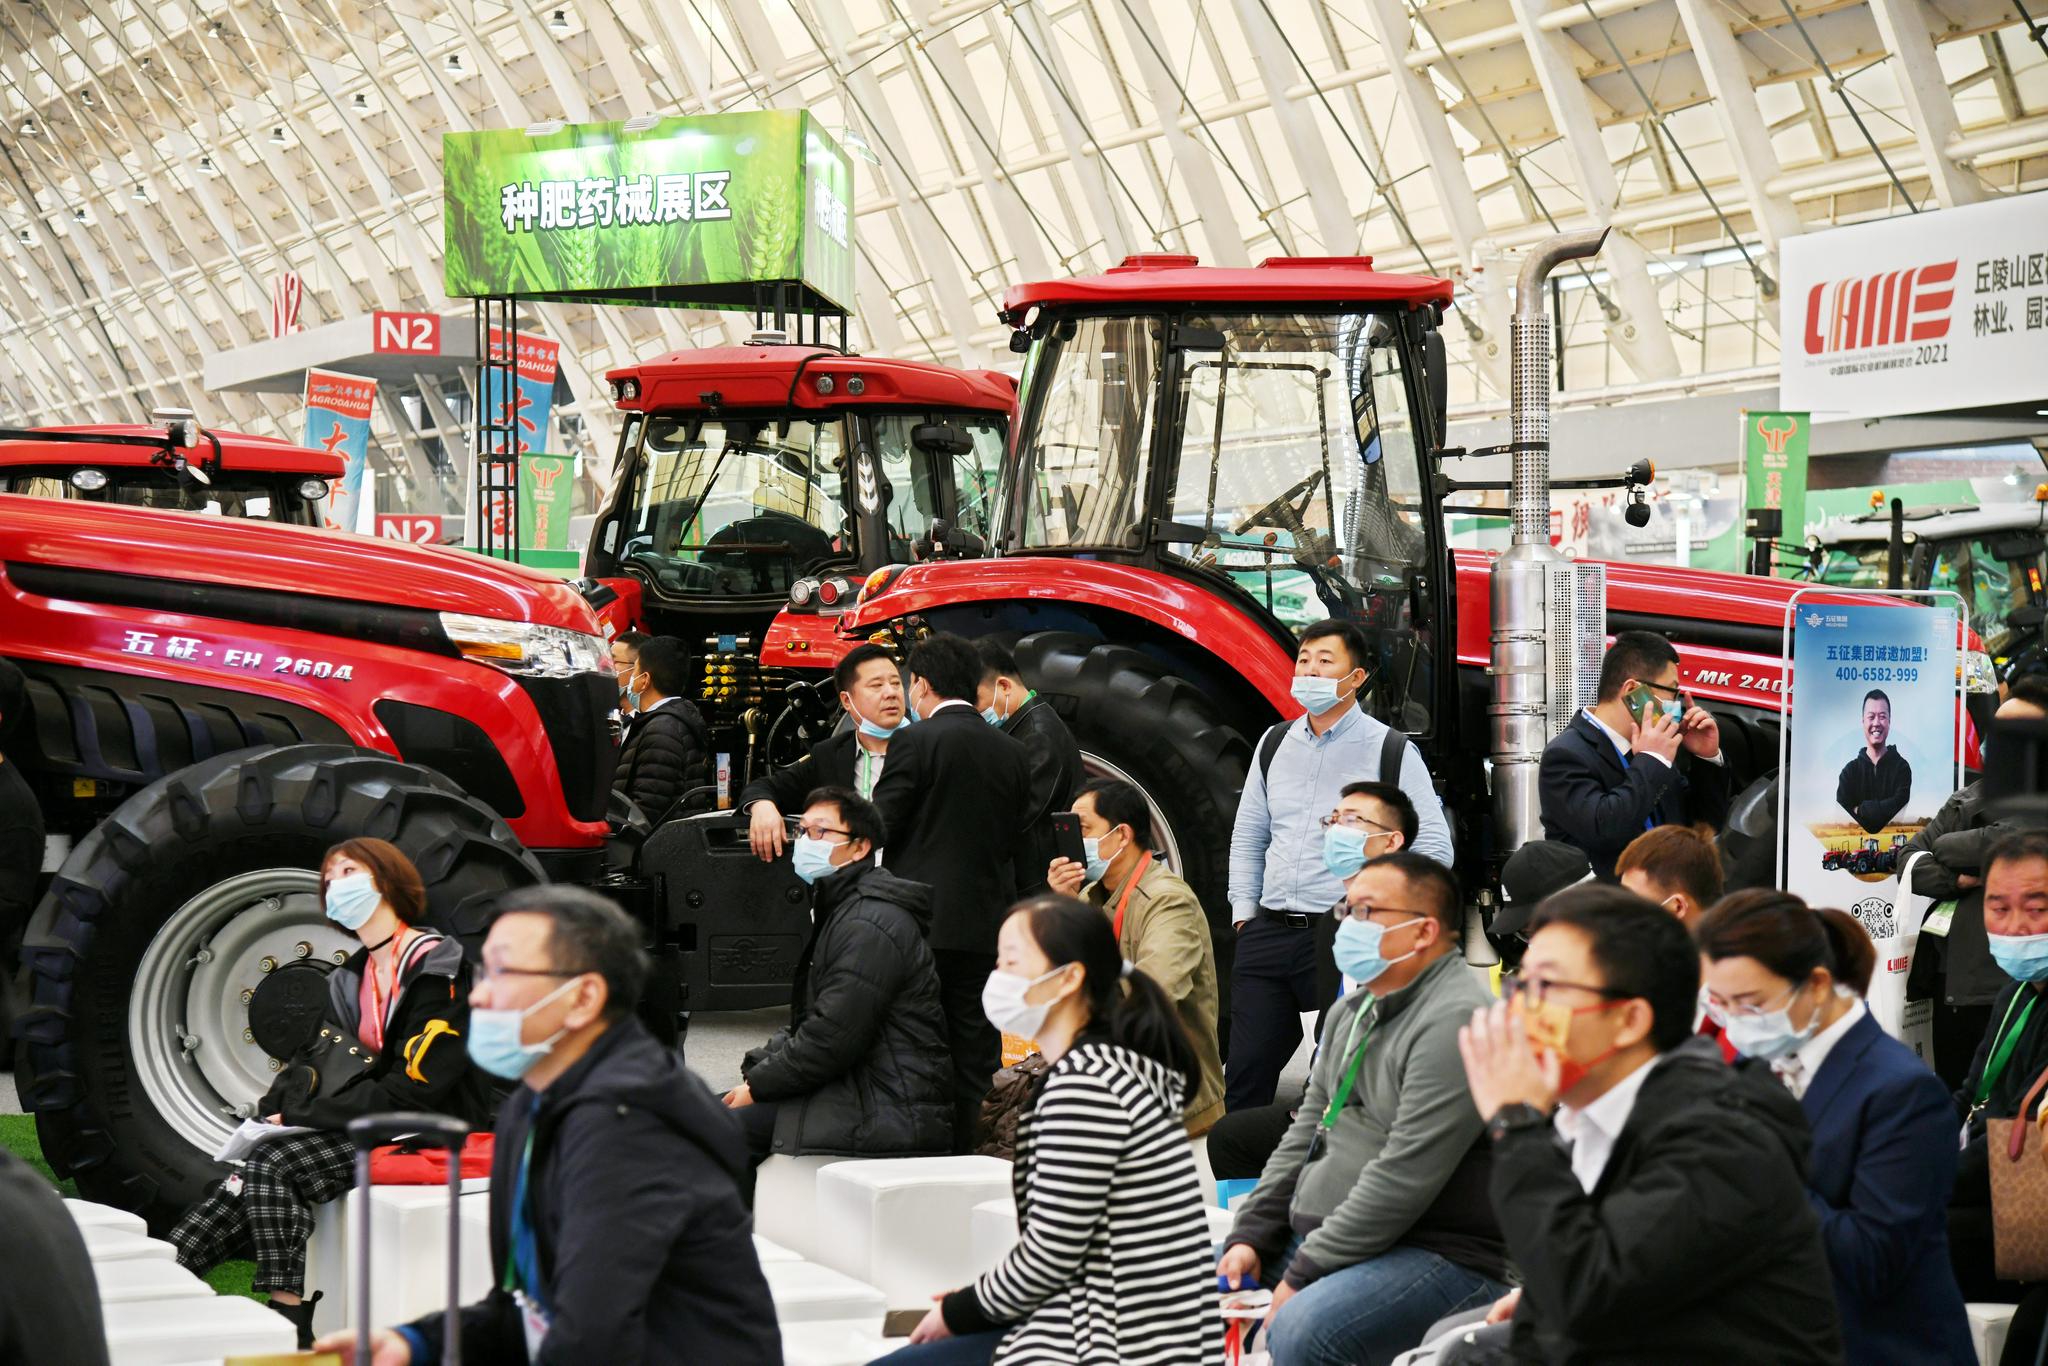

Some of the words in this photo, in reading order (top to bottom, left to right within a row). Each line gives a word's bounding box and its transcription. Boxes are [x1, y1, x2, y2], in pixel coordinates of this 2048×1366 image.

[501, 171, 732, 233] 种肥药械展区
[1975, 250, 2048, 293] 丘陵山区
[272, 271, 302, 338] N2
[380, 316, 433, 350] N2
[1915, 344, 1948, 365] 2021
[310, 394, 370, 411] AGRODAHUA
[382, 519, 435, 545] N2
[224, 649, 262, 668] EH
[273, 656, 353, 681] 2604
[1827, 645, 1928, 662] 五征集团诚邀加盟！
[1695, 669, 1733, 686] MK
[1836, 667, 1918, 682] 400-6582-999
